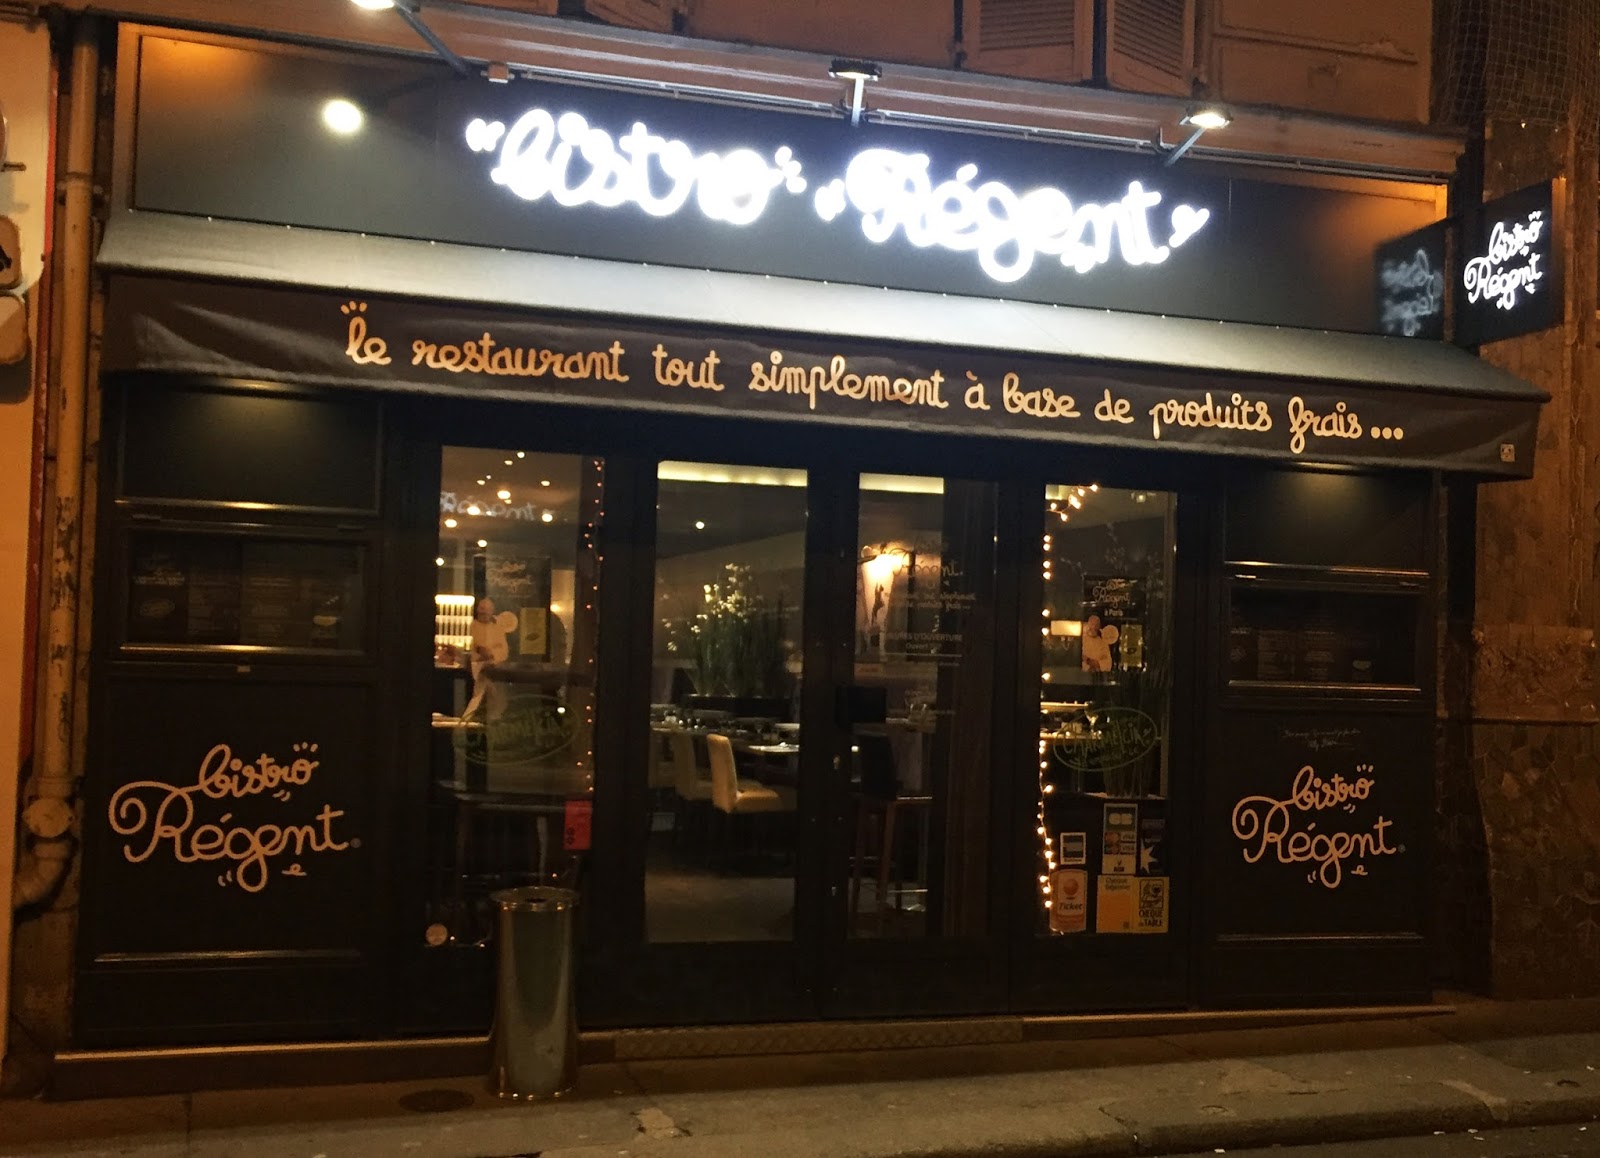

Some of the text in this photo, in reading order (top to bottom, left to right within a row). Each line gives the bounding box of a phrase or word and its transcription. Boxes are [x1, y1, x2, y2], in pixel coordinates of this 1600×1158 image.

[846, 149, 1170, 282] Régent
[1464, 253, 1542, 310] Régent
[345, 316, 391, 364] le
[412, 332, 629, 383] restaurant
[652, 343, 725, 391] tout
[749, 351, 948, 409] simplement
[965, 370, 990, 410] à
[1002, 372, 1081, 418] base
[1094, 388, 1134, 424] de
[1150, 393, 1273, 439] produits
[200, 744, 319, 798] bistro
[1292, 765, 1375, 811] bistro
[108, 781, 349, 892] Régent
[1232, 795, 1397, 889] Régent
